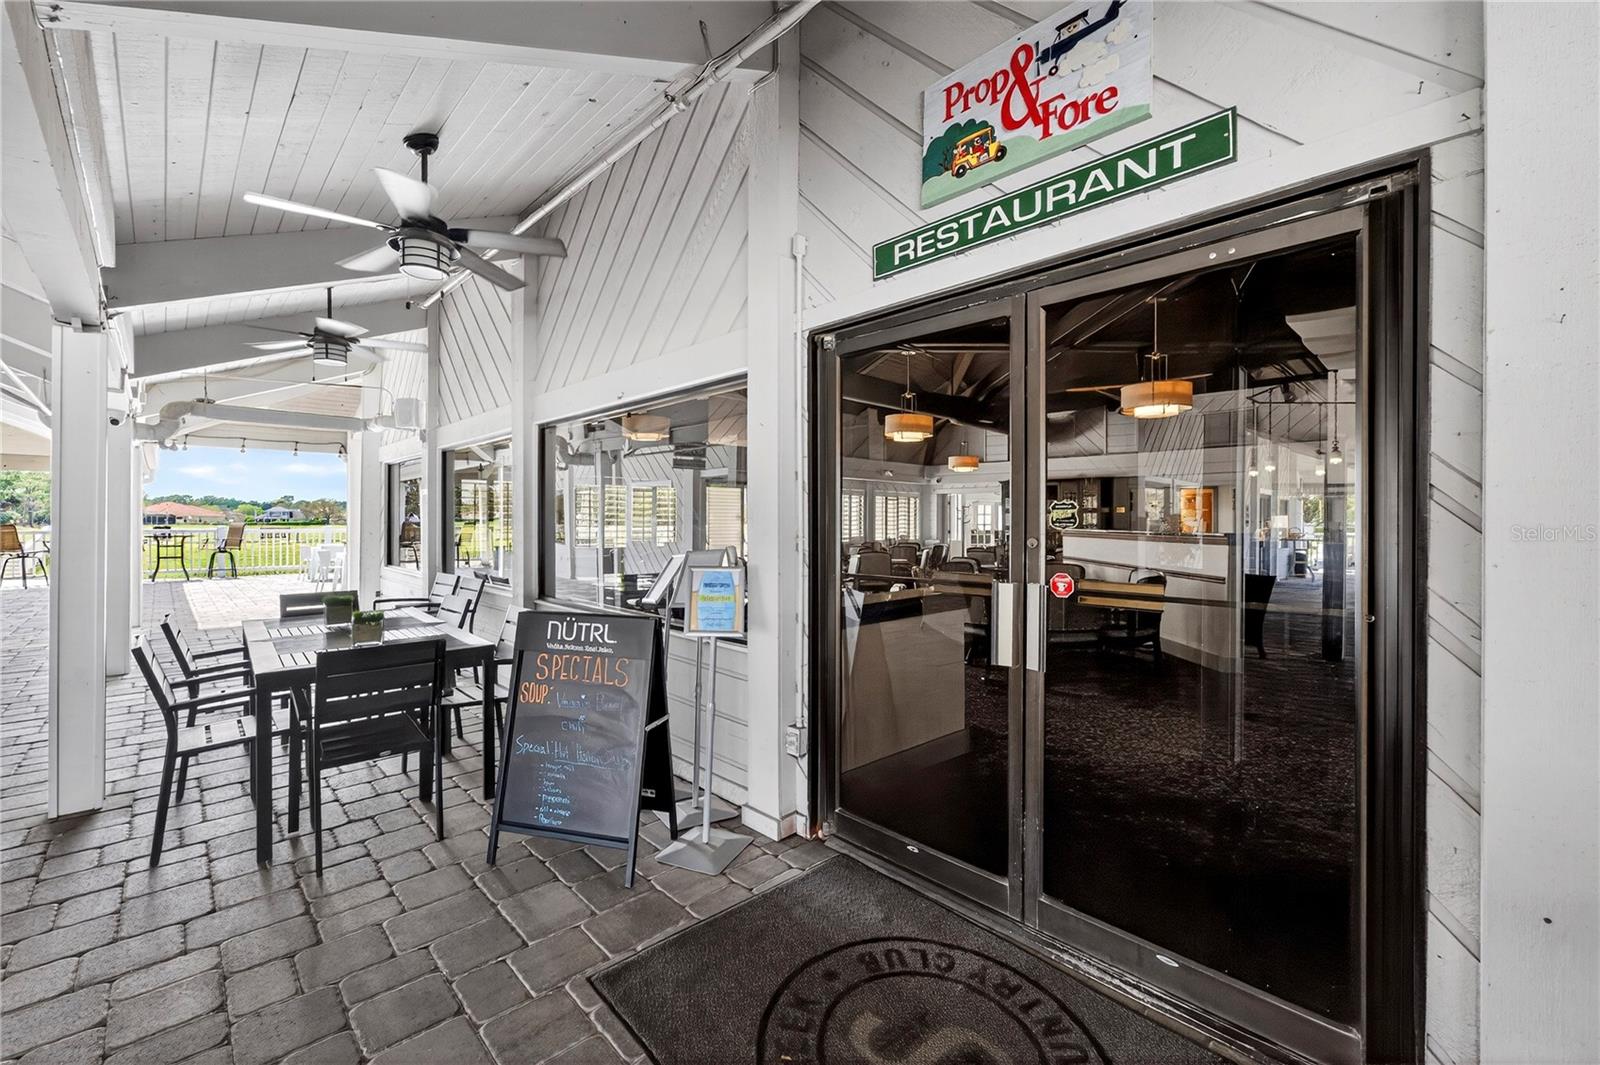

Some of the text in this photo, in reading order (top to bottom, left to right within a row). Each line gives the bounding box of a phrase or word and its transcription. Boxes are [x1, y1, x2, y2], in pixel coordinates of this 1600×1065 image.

[943, 43, 1047, 132] Prop &
[1039, 85, 1119, 141] Fore
[893, 133, 1197, 266] RESTAURANT
[536, 653, 630, 688] SPECIALS
